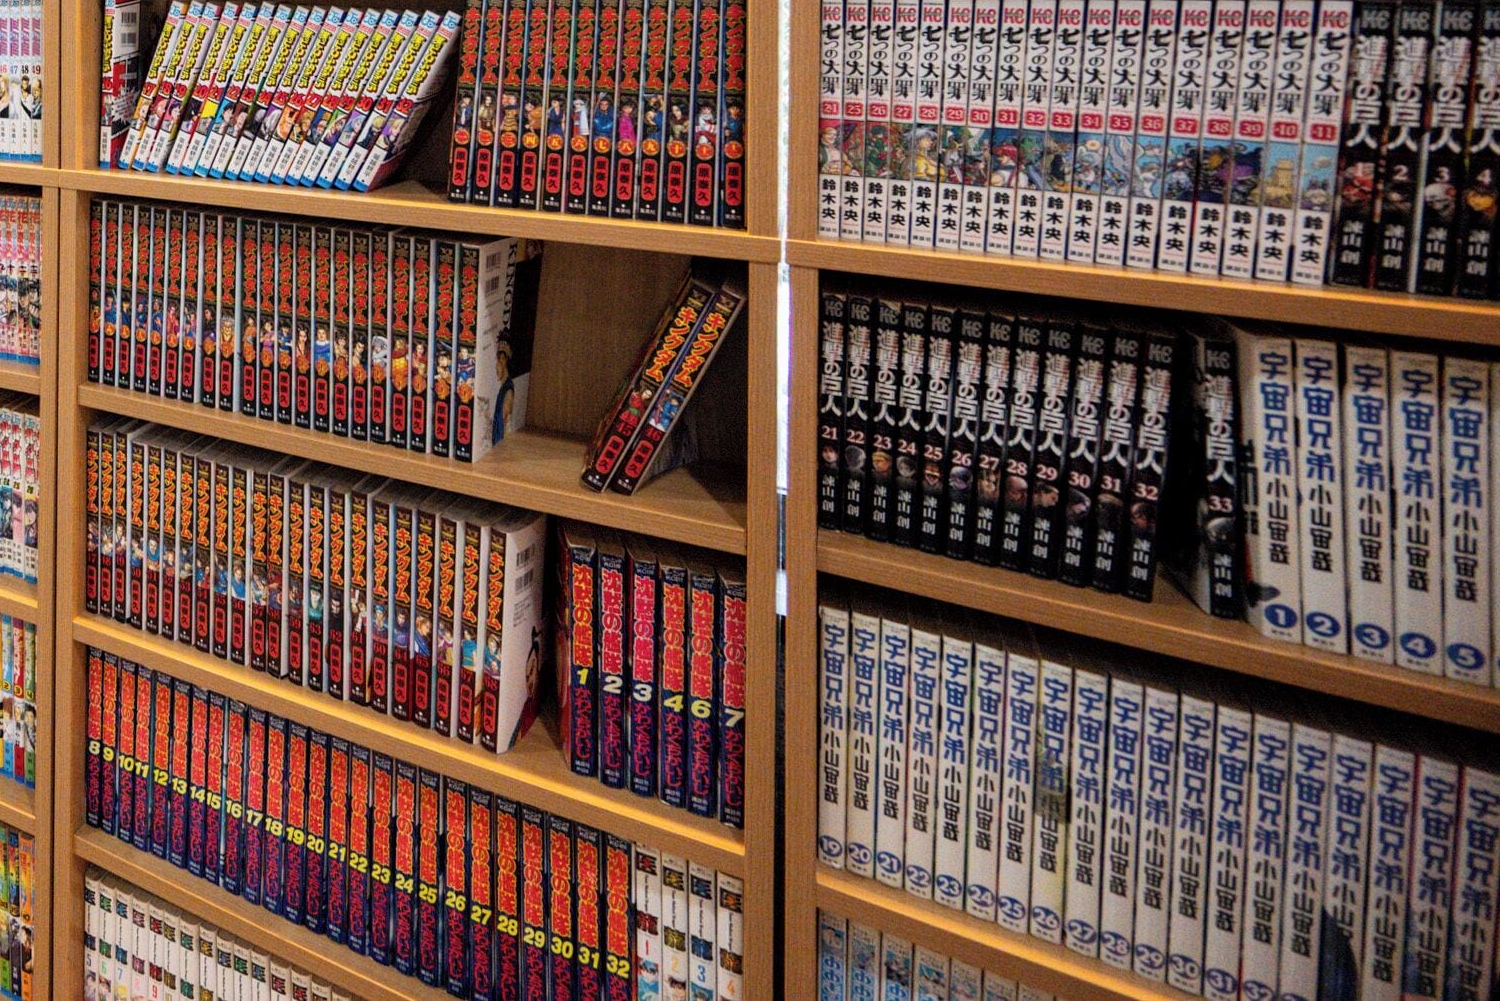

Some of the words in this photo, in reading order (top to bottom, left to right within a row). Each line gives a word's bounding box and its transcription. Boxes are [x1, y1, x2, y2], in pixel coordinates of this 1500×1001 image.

[846, 25, 865, 96] 七つの大罪
[1000, 27, 1024, 103] 七つの大罪
[1243, 30, 1274, 114] 七つの大罪
[1394, 165, 1408, 180] 2
[1435, 167, 1449, 182] 3
[844, 180, 859, 222] 鈴木央
[1102, 200, 1122, 246] 鈴木央
[1230, 207, 1251, 258] 鈴木央
[646, 306, 697, 382] キングダム
[674, 312, 726, 387] キングダム
[821, 321, 844, 417] 進撃の巨人
[1136, 366, 1171, 474] 進撃の巨人
[1259, 352, 1291, 476] 宇宙兄弟
[1304, 357, 1334, 482] 宇宙兄弟
[821, 426, 838, 440] 21
[1205, 374, 1235, 485] 進撃の巨人
[1352, 363, 1385, 491] 宇宙兄弟
[873, 435, 893, 450] 23
[924, 444, 943, 460] 25
[1449, 376, 1483, 508] 宇宙兄弟
[1007, 459, 1028, 475] 28
[1068, 472, 1091, 489] 30
[1135, 484, 1158, 500] 32
[1209, 496, 1233, 513] 33
[1266, 477, 1290, 565] 小山宙哉
[1358, 494, 1382, 583] 小山宙哉
[1453, 510, 1479, 602] 小山宙哉
[463, 545, 478, 623] キングダム
[488, 552, 504, 630] キングダム
[577, 669, 588, 684] 1
[603, 676, 623, 694] 2
[823, 625, 845, 730] 宇宙兄弟
[884, 635, 906, 743] 宇宙兄弟
[664, 695, 684, 712] 4
[691, 700, 711, 718] 6
[1008, 671, 1034, 784] 宇宙兄弟
[103, 748, 114, 761] 9
[824, 731, 840, 805] 小山宙哉
[1181, 713, 1210, 835] 宇宙兄弟
[226, 801, 242, 817] 16
[286, 827, 305, 844] 19
[820, 838, 841, 855] 19
[350, 854, 368, 872] 22
[879, 854, 899, 871] 21
[419, 884, 437, 903] 25
[937, 877, 960, 893] 23
[1001, 900, 1025, 917] 25
[499, 916, 518, 936] 28
[552, 937, 573, 958] 30
[607, 955, 630, 978] 32
[698, 966, 706, 982] 3
[1171, 957, 1198, 976] 30
